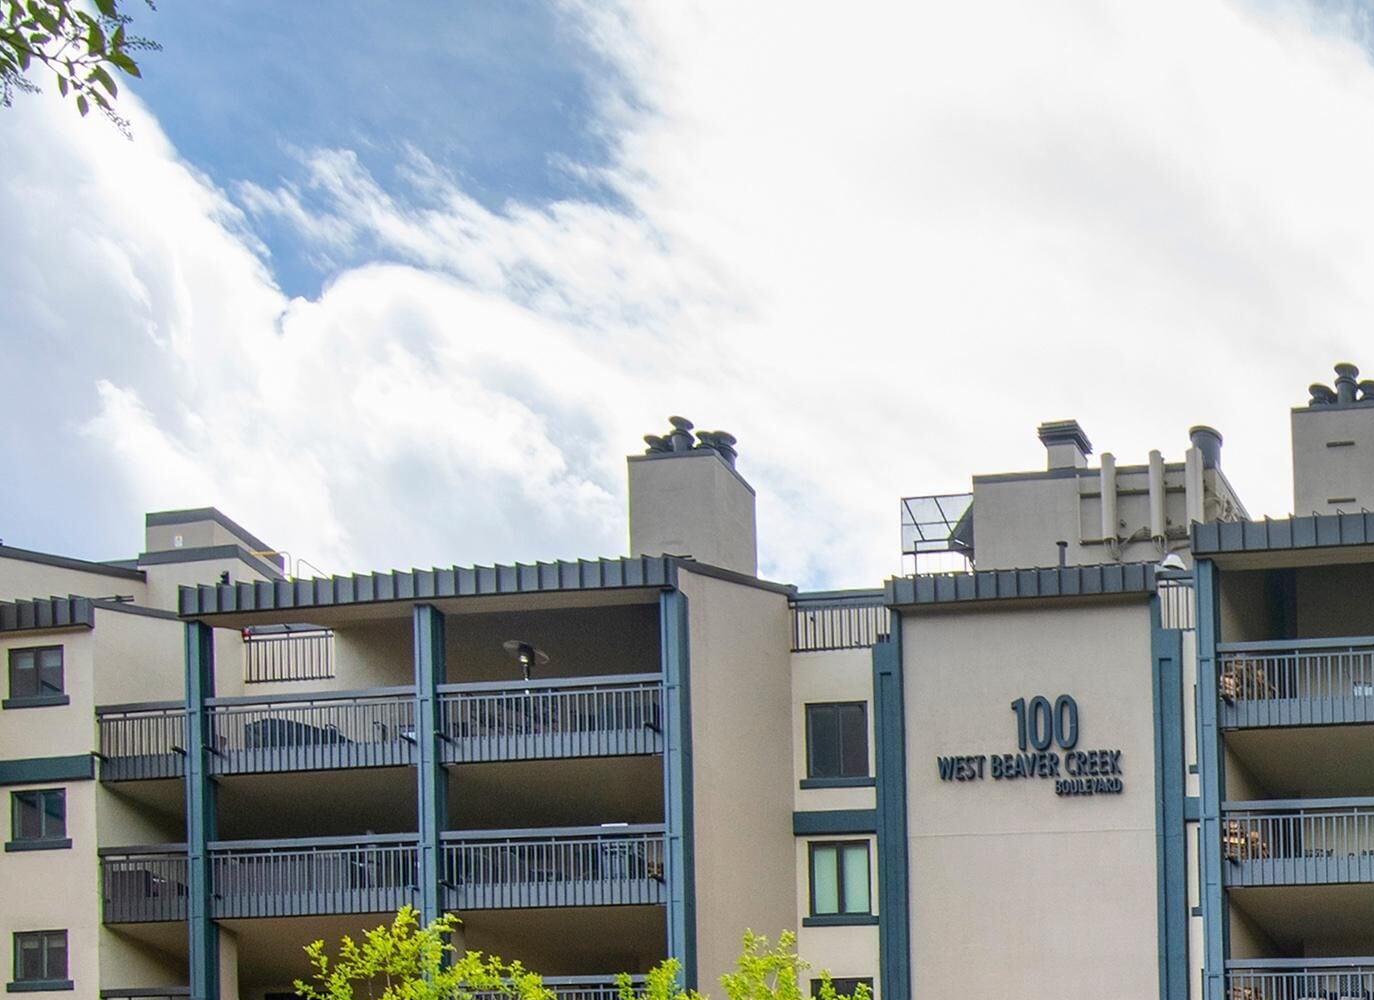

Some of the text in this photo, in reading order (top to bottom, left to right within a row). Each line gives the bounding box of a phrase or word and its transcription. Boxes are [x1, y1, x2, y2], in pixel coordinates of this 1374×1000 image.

[1011, 694, 1079, 750] 100
[937, 749, 1123, 781] WEST BEAVER CREEK
[1055, 777, 1123, 797] BOULEVARD
